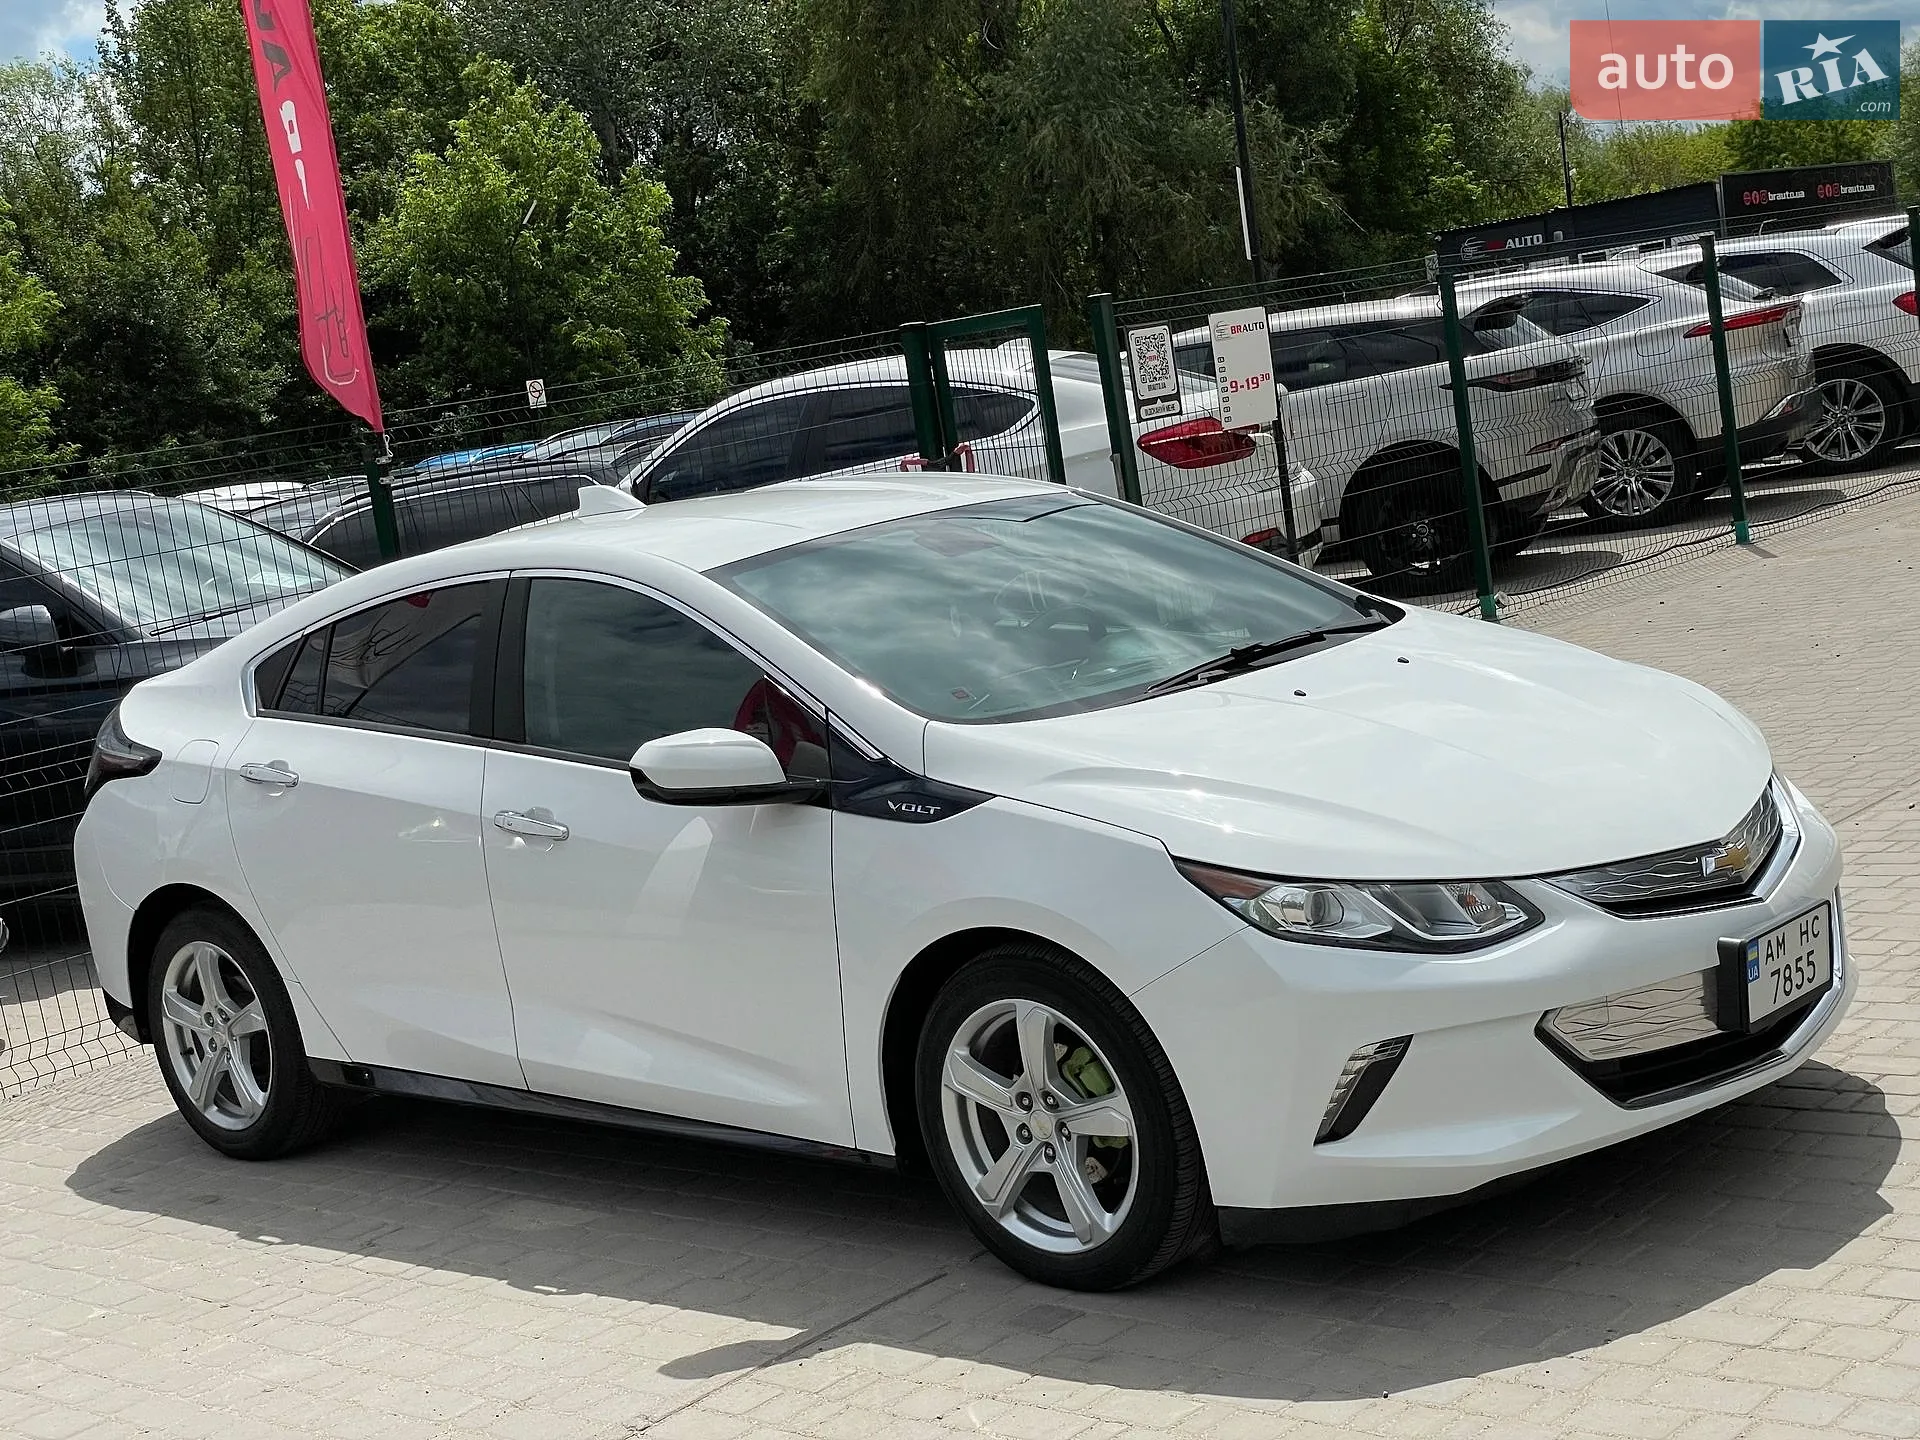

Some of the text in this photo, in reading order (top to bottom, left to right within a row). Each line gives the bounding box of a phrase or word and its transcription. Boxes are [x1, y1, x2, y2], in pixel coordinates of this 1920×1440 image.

[1767, 190, 1805, 201] brauto.ua
[1840, 184, 1876, 194] brauto.ua
[1230, 321, 1265, 335] BRAUTO
[887, 799, 942, 815] VOLT
[1765, 915, 1820, 965] AM HC
[1748, 966, 1759, 980] UA
[1770, 949, 1816, 1005] 7855
